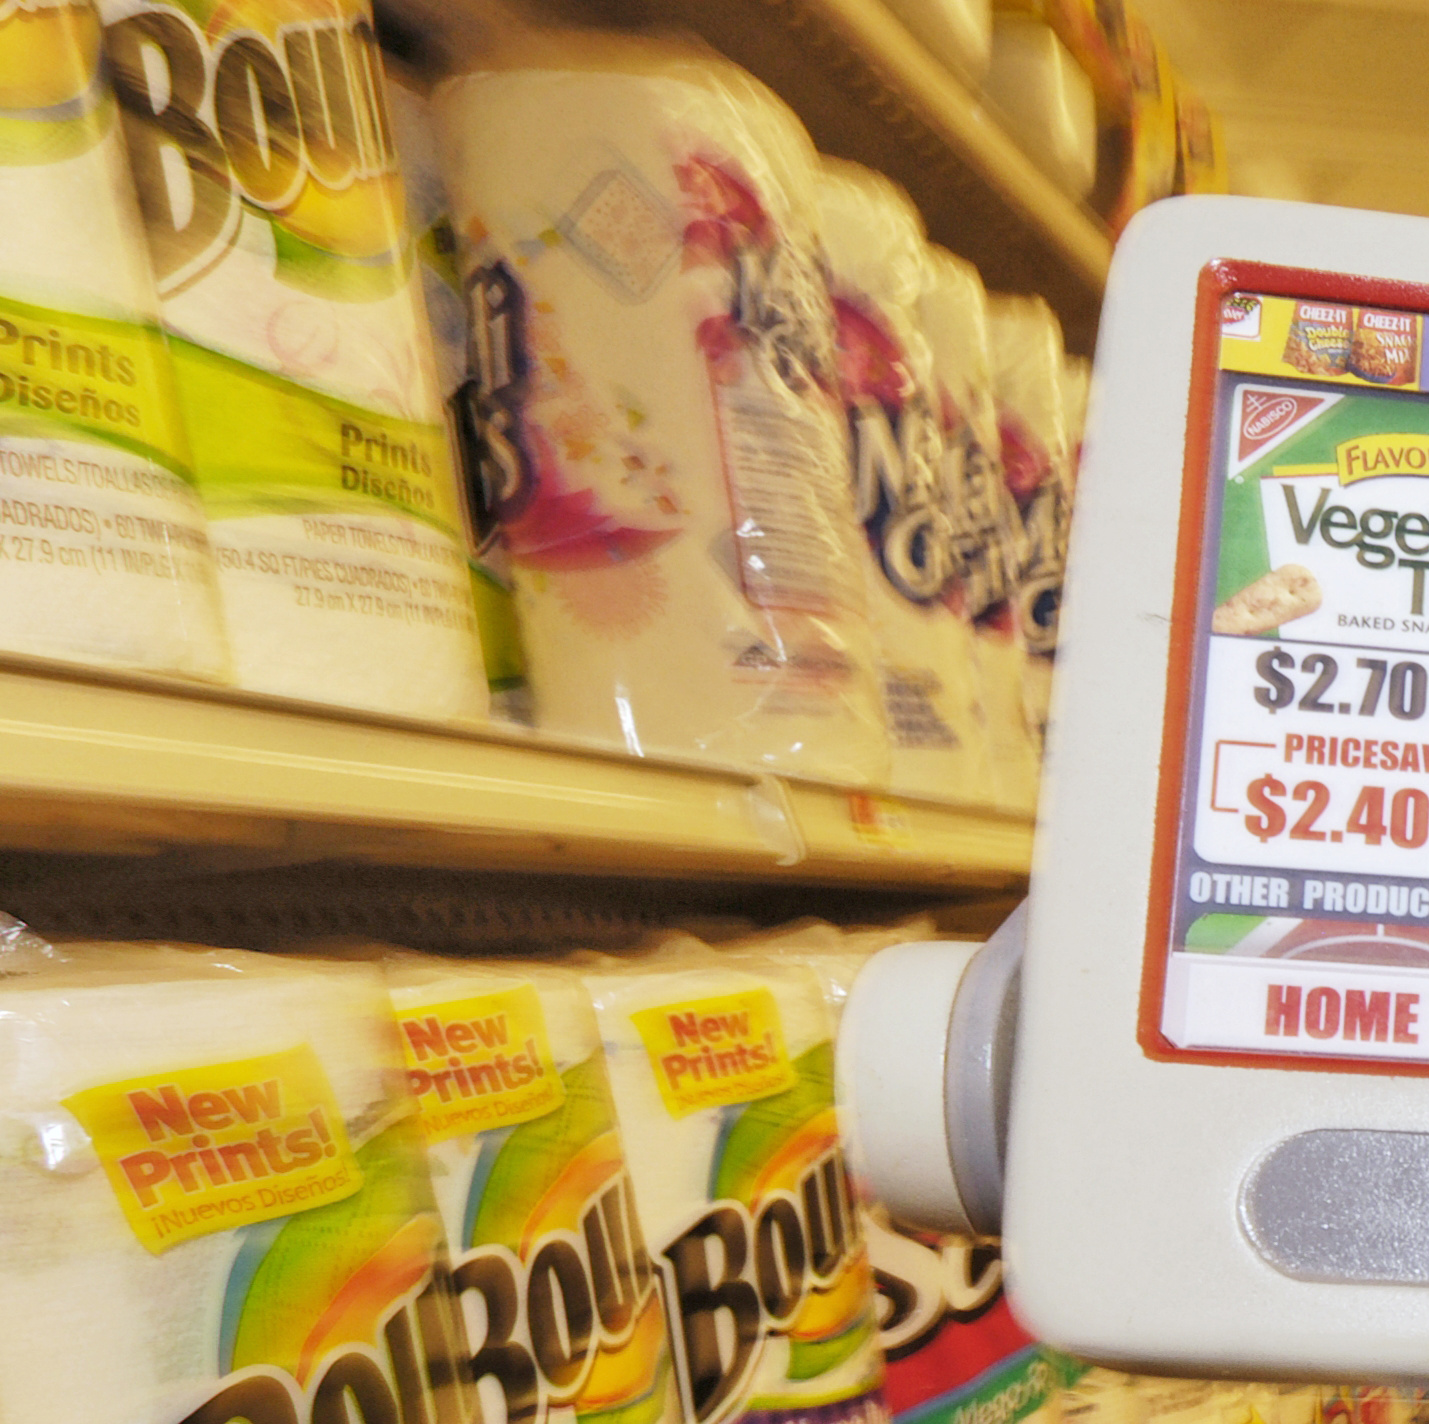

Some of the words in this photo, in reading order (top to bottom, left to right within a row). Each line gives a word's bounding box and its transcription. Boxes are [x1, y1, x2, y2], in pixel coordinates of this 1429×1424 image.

[1247, 400, 1293, 437] NABISCO
[340, 422, 432, 478] Prints
[1337, 612, 1395, 632] BAKED
[1252, 646, 1428, 721] $2.70
[1189, 871, 1290, 909] OTHER
[402, 1013, 509, 1061] New
[666, 1009, 750, 1049] New
[1263, 983, 1420, 1045] HOME
[658, 1031, 777, 1092] Prints!
[127, 1078, 283, 1143] New
[119, 1105, 338, 1210] Prints!
